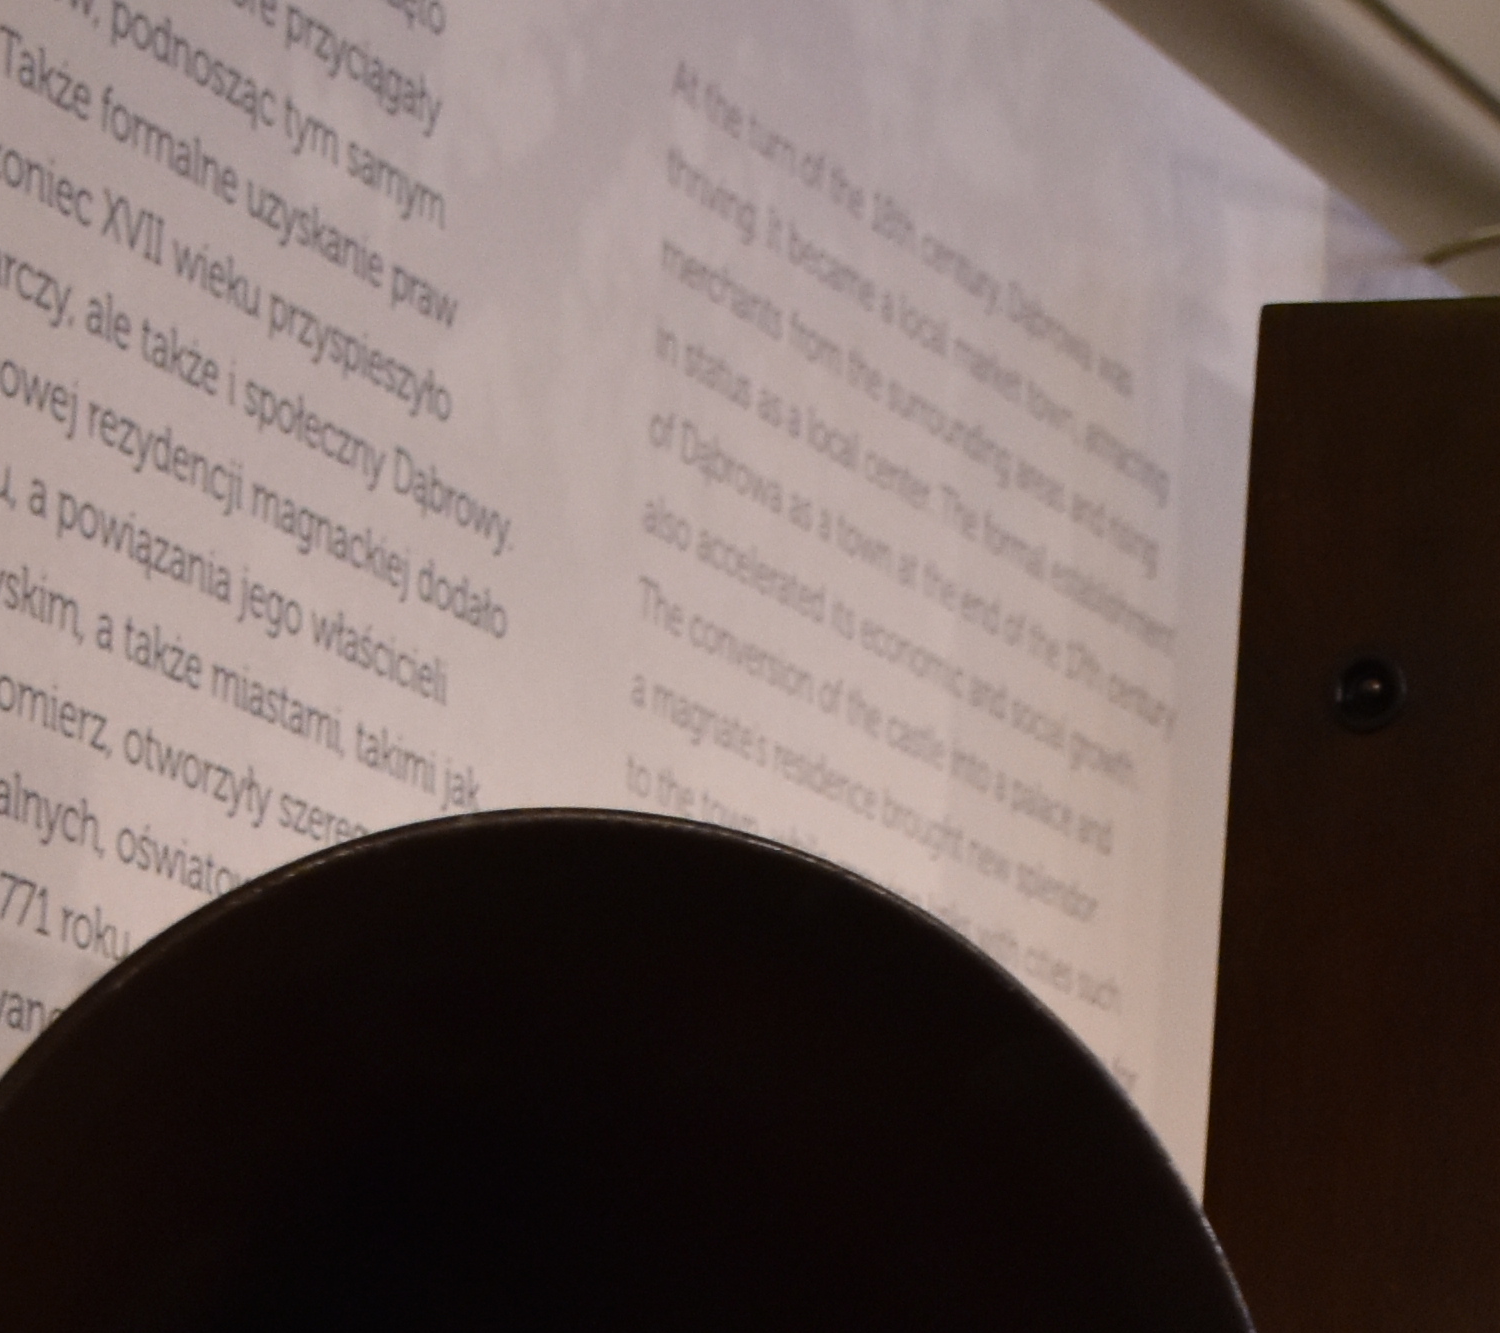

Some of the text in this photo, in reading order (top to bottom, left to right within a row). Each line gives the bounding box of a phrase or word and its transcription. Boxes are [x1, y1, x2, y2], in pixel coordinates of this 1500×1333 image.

[100, 84, 239, 206] formalne
[246, 180, 384, 289] uzyskanie
[390, 264, 459, 329] praw
[283, 95, 339, 166] tym
[347, 140, 445, 229] samym
[85, 292, 132, 352] ale
[141, 318, 220, 397] także
[227, 359, 237, 407] i
[244, 379, 387, 493] społeczny
[101, 188, 165, 267] XVII
[172, 240, 261, 319] wieku
[268, 293, 452, 423] przyspieszyło
[27, 477, 48, 519] a
[56, 490, 232, 605] powiązania
[236, 577, 303, 640] jego
[311, 610, 447, 706] właścicieli
[88, 401, 243, 517] rezydencji
[251, 482, 409, 604] magnackiej
[417, 558, 508, 640] dodało
[95, 612, 114, 653] a
[124, 618, 203, 691] także
[211, 663, 344, 756] miastami,
[440, 767, 480, 817] jak
[123, 728, 272, 830] otworzyły
